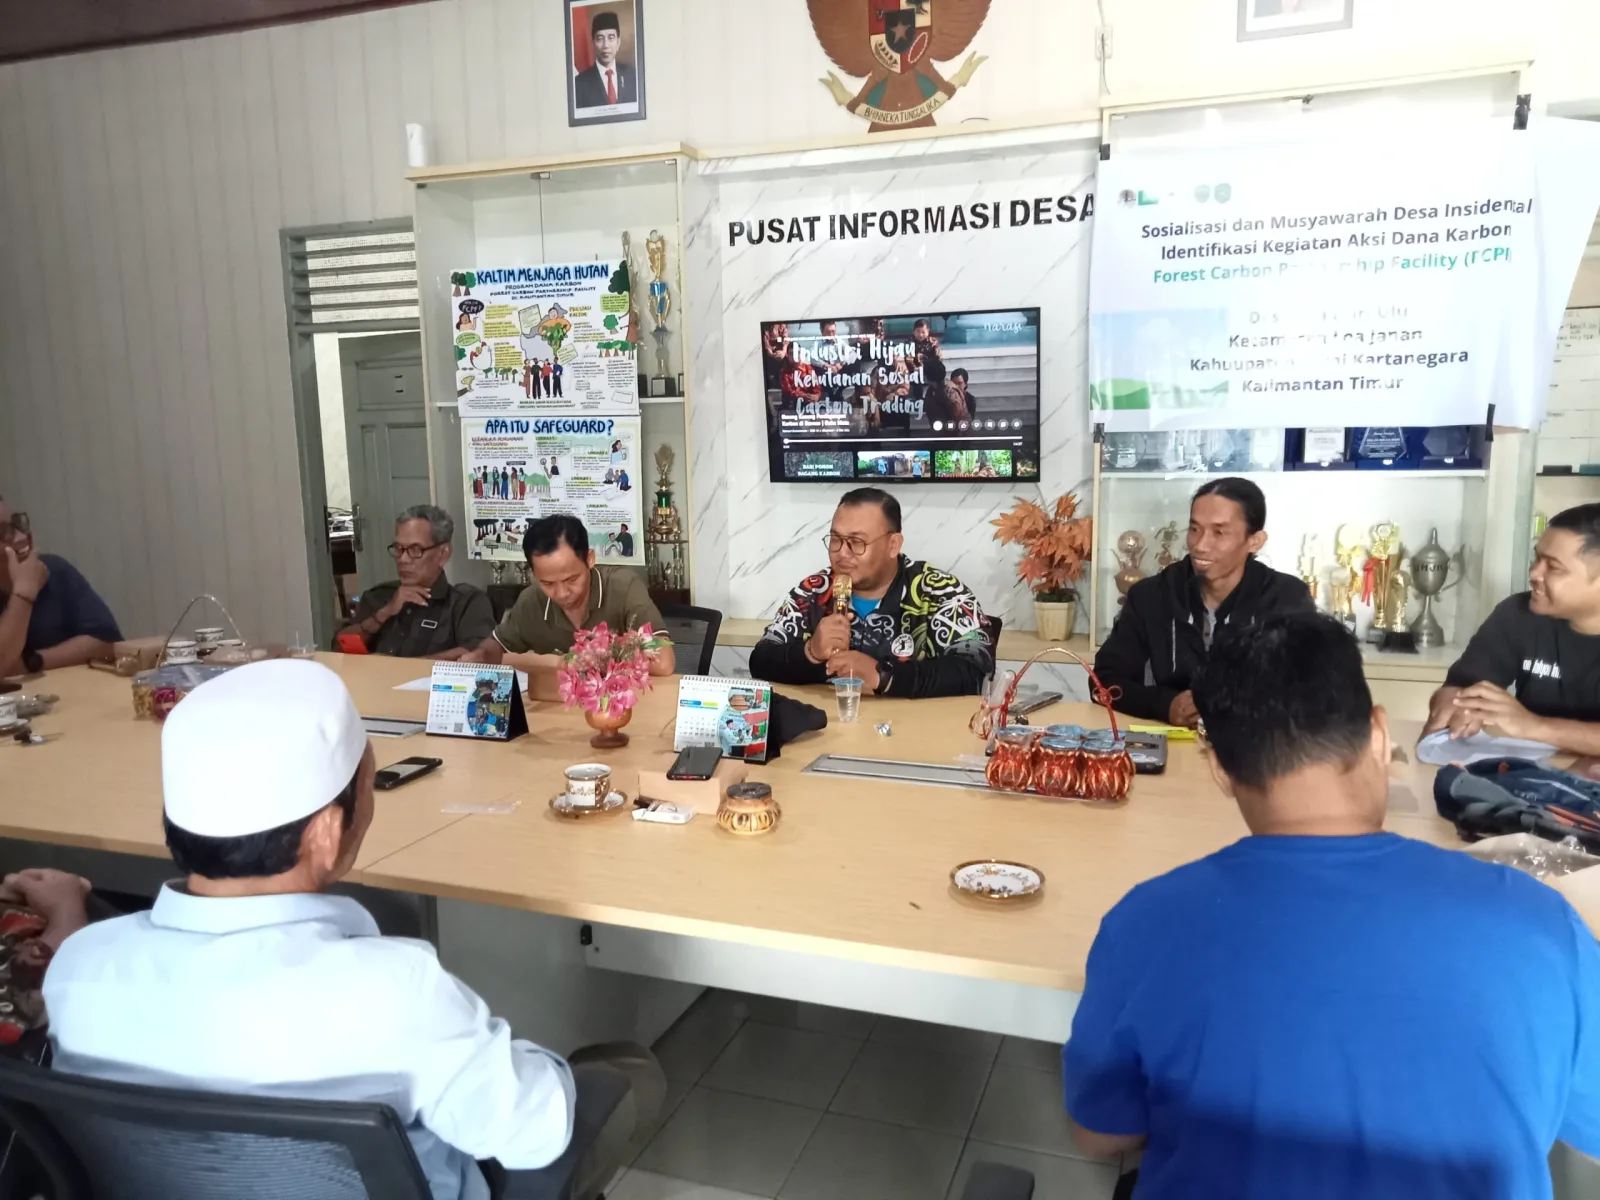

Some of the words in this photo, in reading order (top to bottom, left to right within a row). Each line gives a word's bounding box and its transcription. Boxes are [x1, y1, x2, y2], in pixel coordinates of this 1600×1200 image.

[729, 216, 820, 247] PUSAT
[829, 201, 1001, 240] INFORMASI
[1010, 193, 1094, 228] DESA
[1142, 219, 1227, 239] Sosialisasi
[1233, 218, 1264, 232] dan
[1271, 208, 1388, 231] Musyawarah
[1394, 206, 1438, 221] Desa
[1161, 240, 1257, 260] Identifikasi
[1263, 237, 1341, 255] Kegiatan
[1348, 231, 1386, 247] Aksi
[1392, 230, 1439, 246] Dana
[1446, 223, 1511, 242] Karbon
[476, 269, 517, 284] KALTIM
[518, 267, 571, 282] MENJAGA
[574, 264, 609, 279] HUTAN
[1154, 267, 1206, 284] Forest
[1211, 264, 1272, 280] Carbon
[1392, 253, 1458, 270] Facility
[869, 337, 916, 366] Hijau
[1353, 350, 1469, 368] Kartanegara
[793, 368, 872, 388] Kehutanan
[878, 366, 925, 386] Sosial
[1242, 378, 1344, 393] Kalimantan
[1349, 375, 1404, 390] Timur
[860, 395, 925, 420] Trading
[485, 419, 508, 434] APA
[510, 420, 530, 434] ITU
[533, 419, 614, 436] SAFEGUARD?
